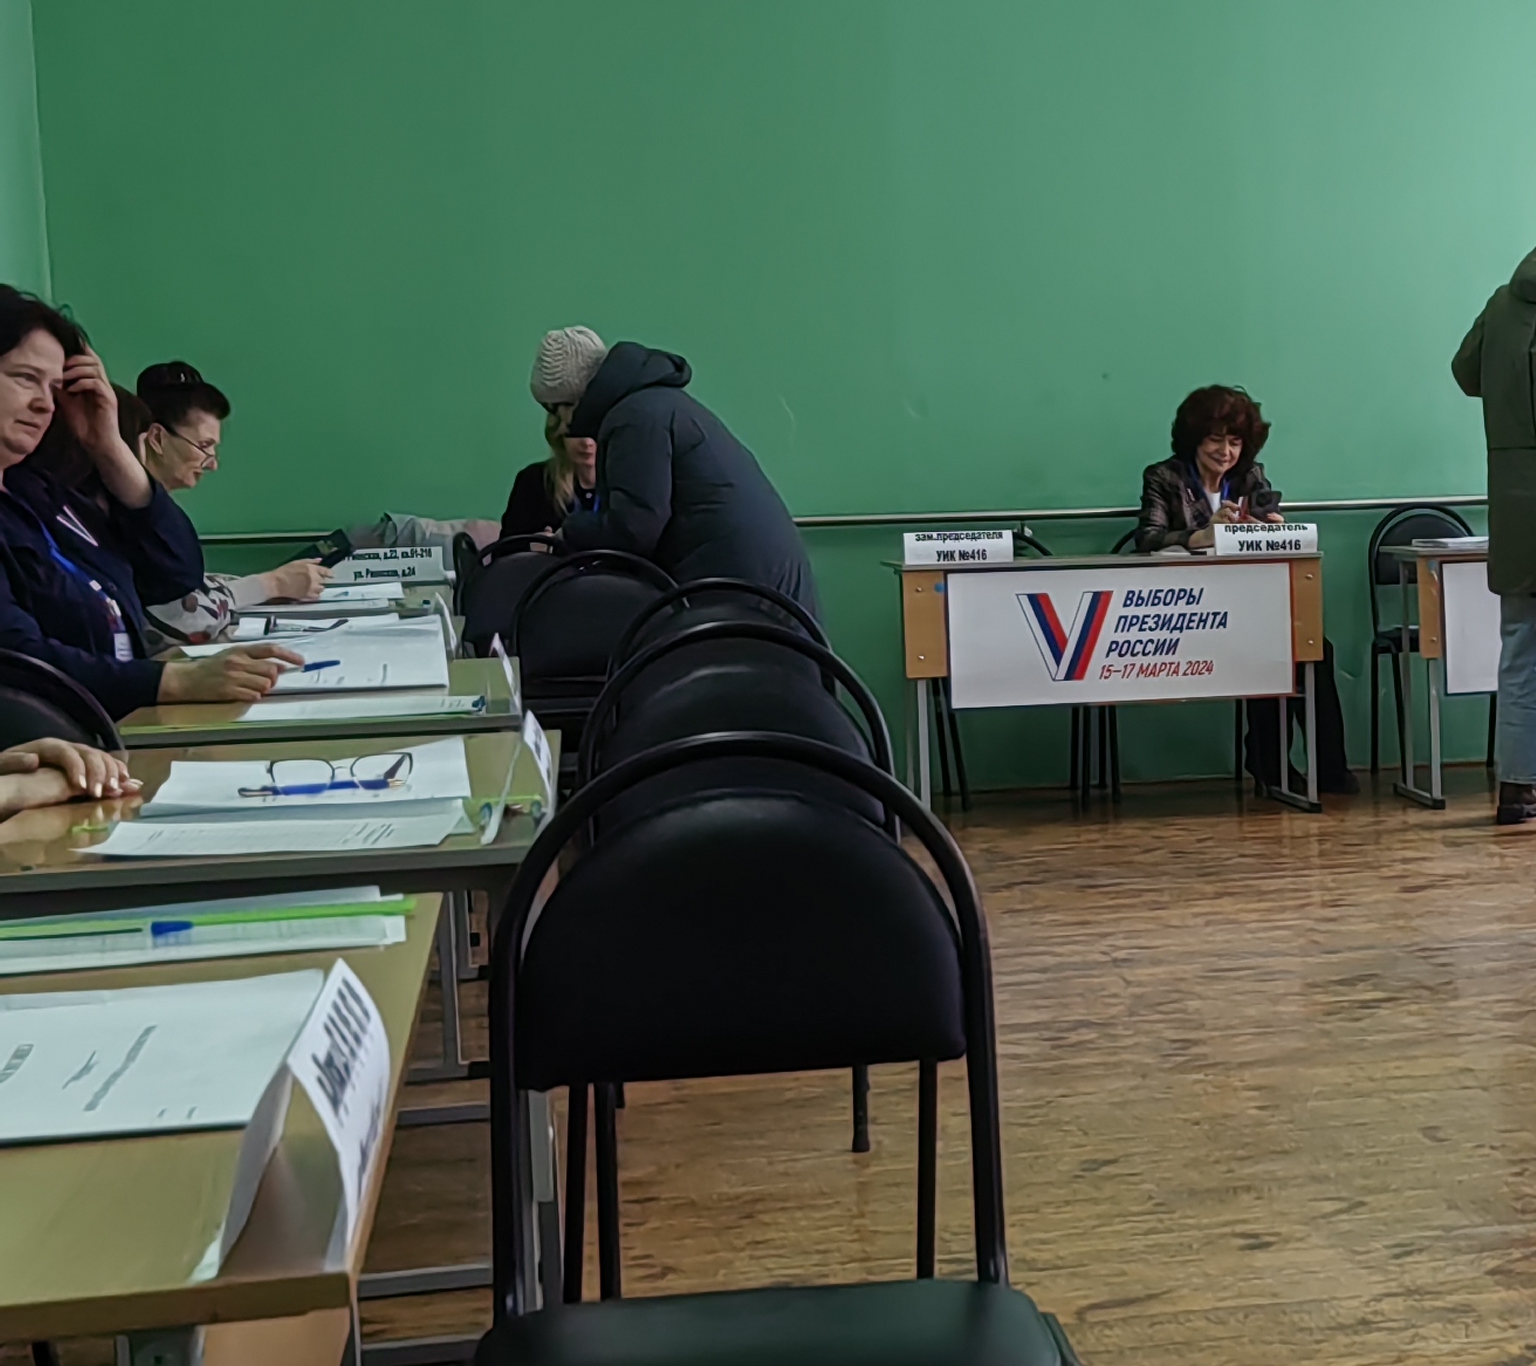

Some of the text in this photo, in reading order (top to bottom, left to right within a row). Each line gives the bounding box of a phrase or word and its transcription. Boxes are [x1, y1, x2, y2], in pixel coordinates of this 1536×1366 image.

[1224, 523, 1309, 535] председатель
[936, 548, 988, 563] УИК №416
[1238, 538, 1302, 552] УИК №416
[1122, 586, 1205, 609] ВЫБОРЫ
[1113, 610, 1229, 635] ПРЕЗИДЕНТА
[1105, 636, 1181, 659] РОССИИ
[1136, 660, 1181, 680] МАРТА
[1182, 659, 1214, 677] 2024
